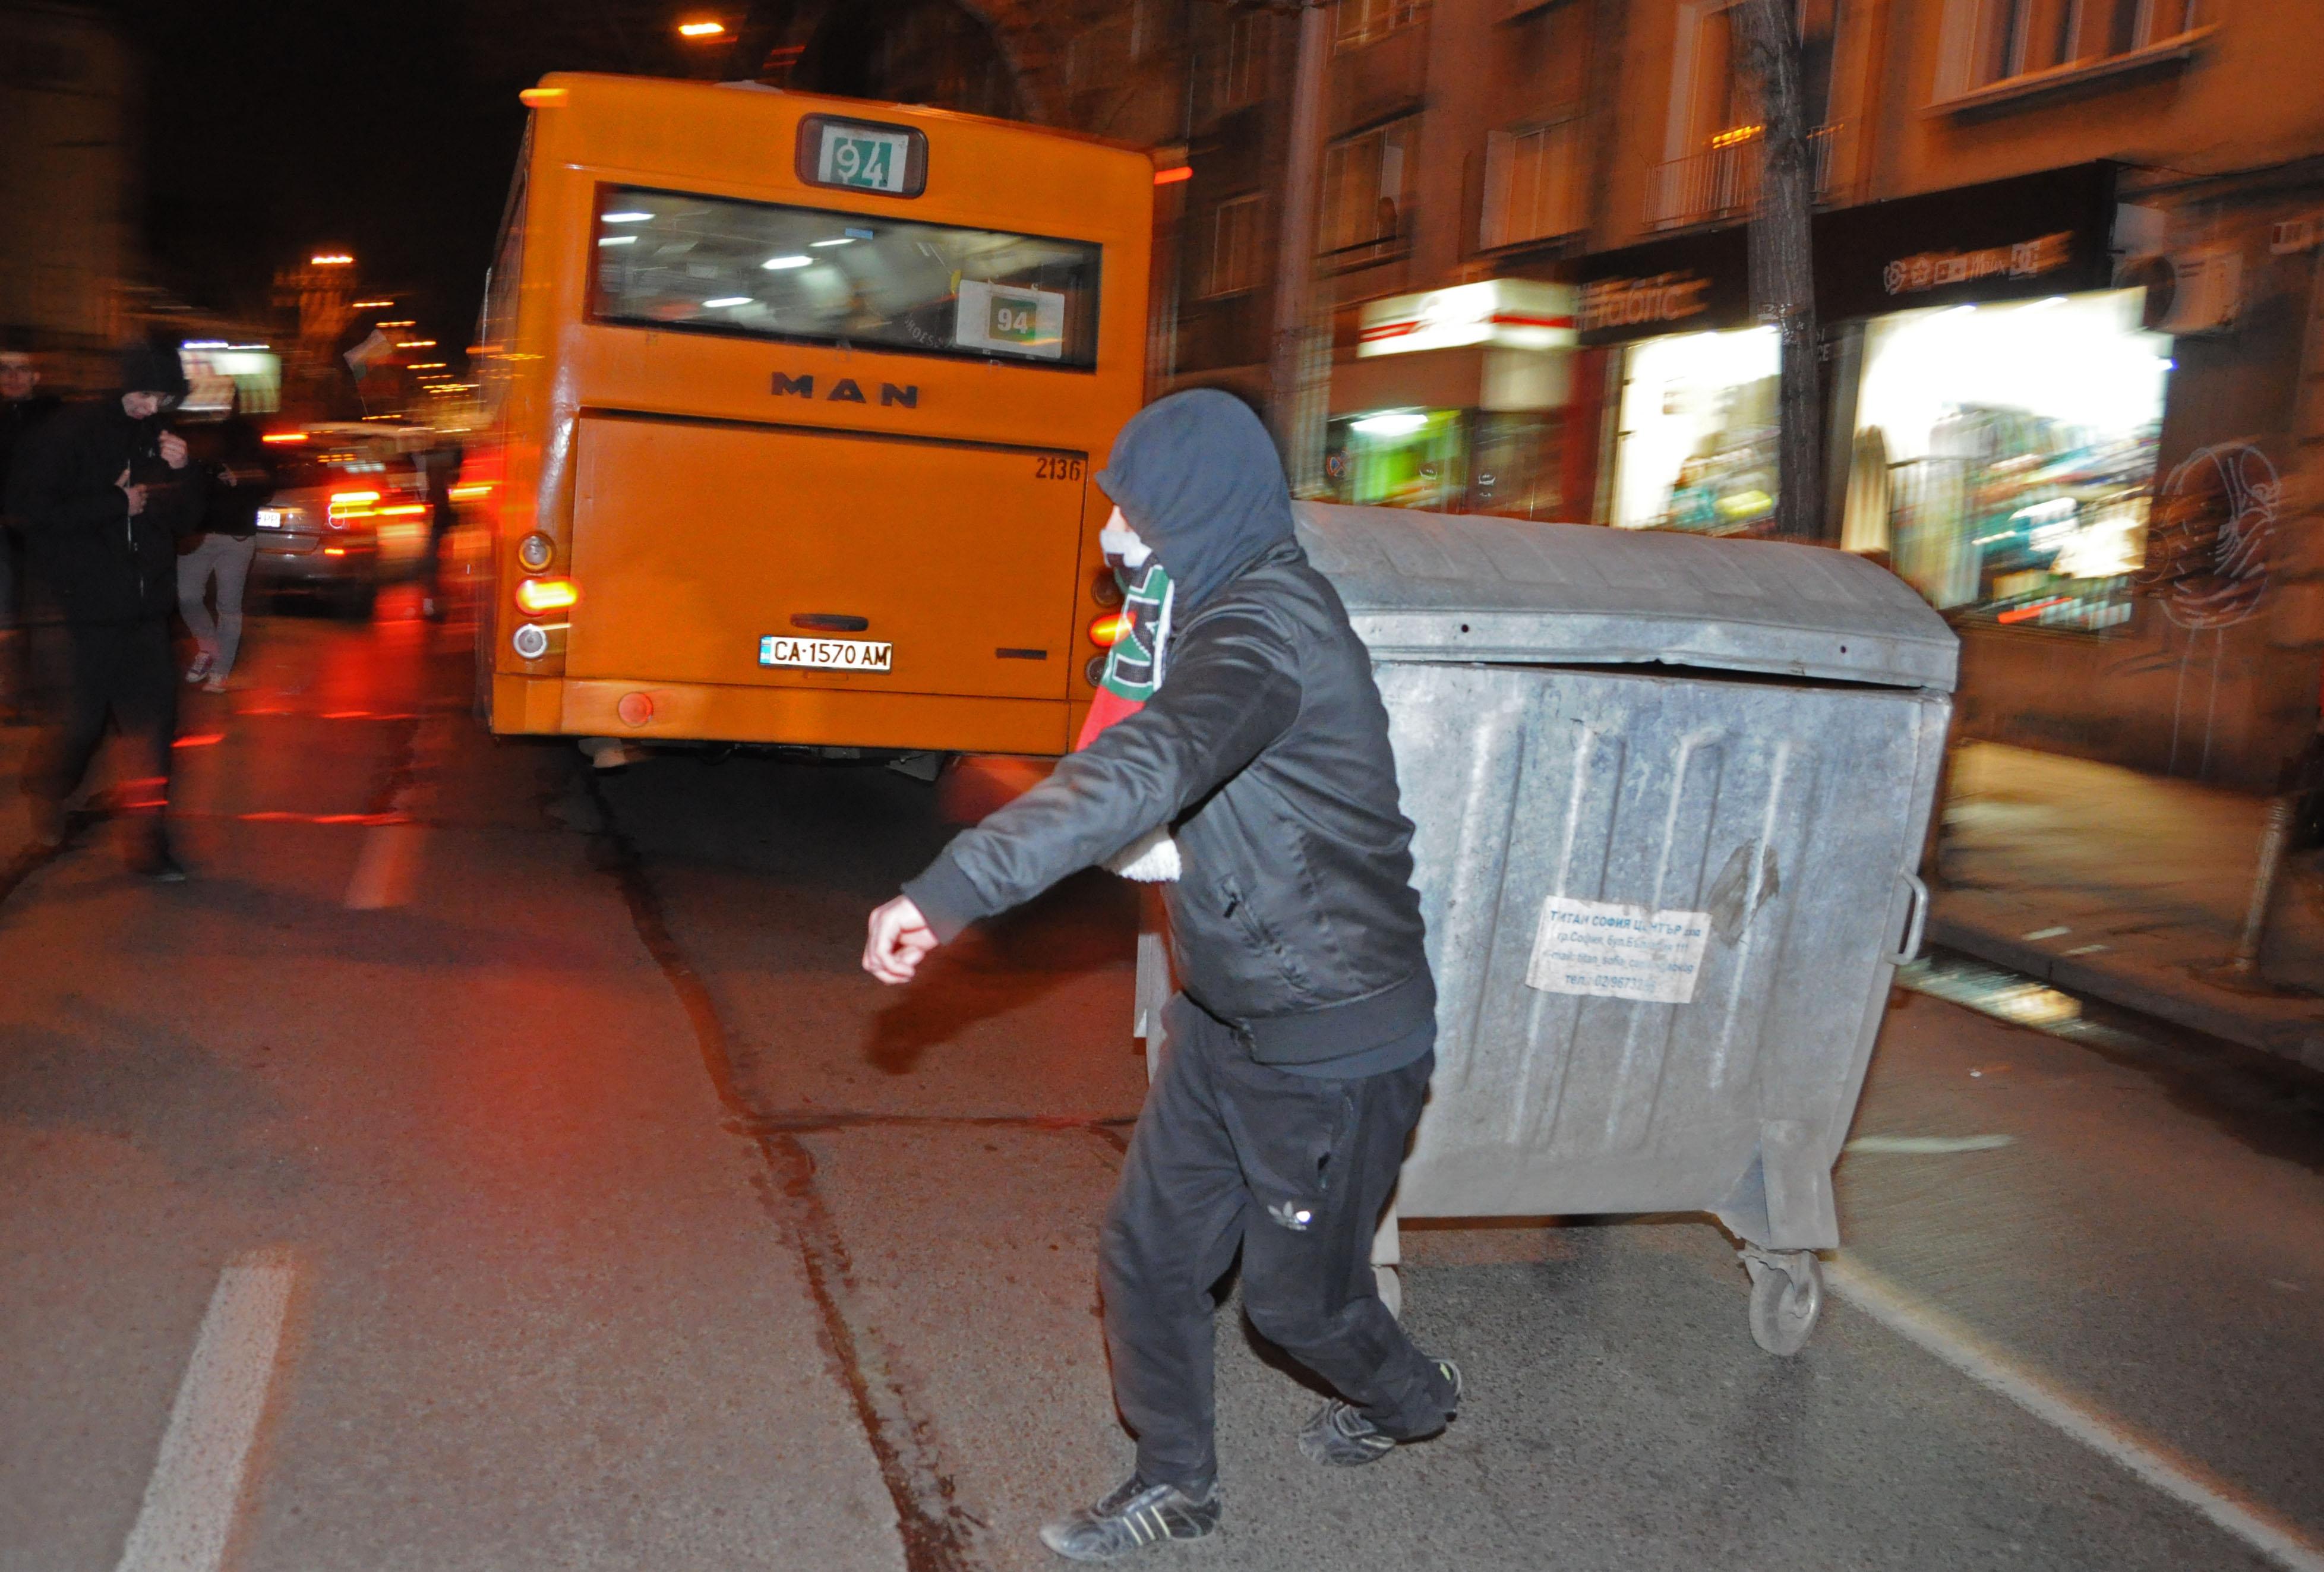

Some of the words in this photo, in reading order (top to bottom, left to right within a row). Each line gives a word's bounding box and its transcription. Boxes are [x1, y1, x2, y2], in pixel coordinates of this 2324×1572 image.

[836, 141, 883, 187] 94
[997, 308, 1028, 333] 94
[771, 371, 918, 408] MAN
[1035, 457, 1081, 481] 2136
[810, 643, 856, 664] 1570
[861, 645, 891, 666] AM
[1592, 916, 1631, 930] СОФИЯ
